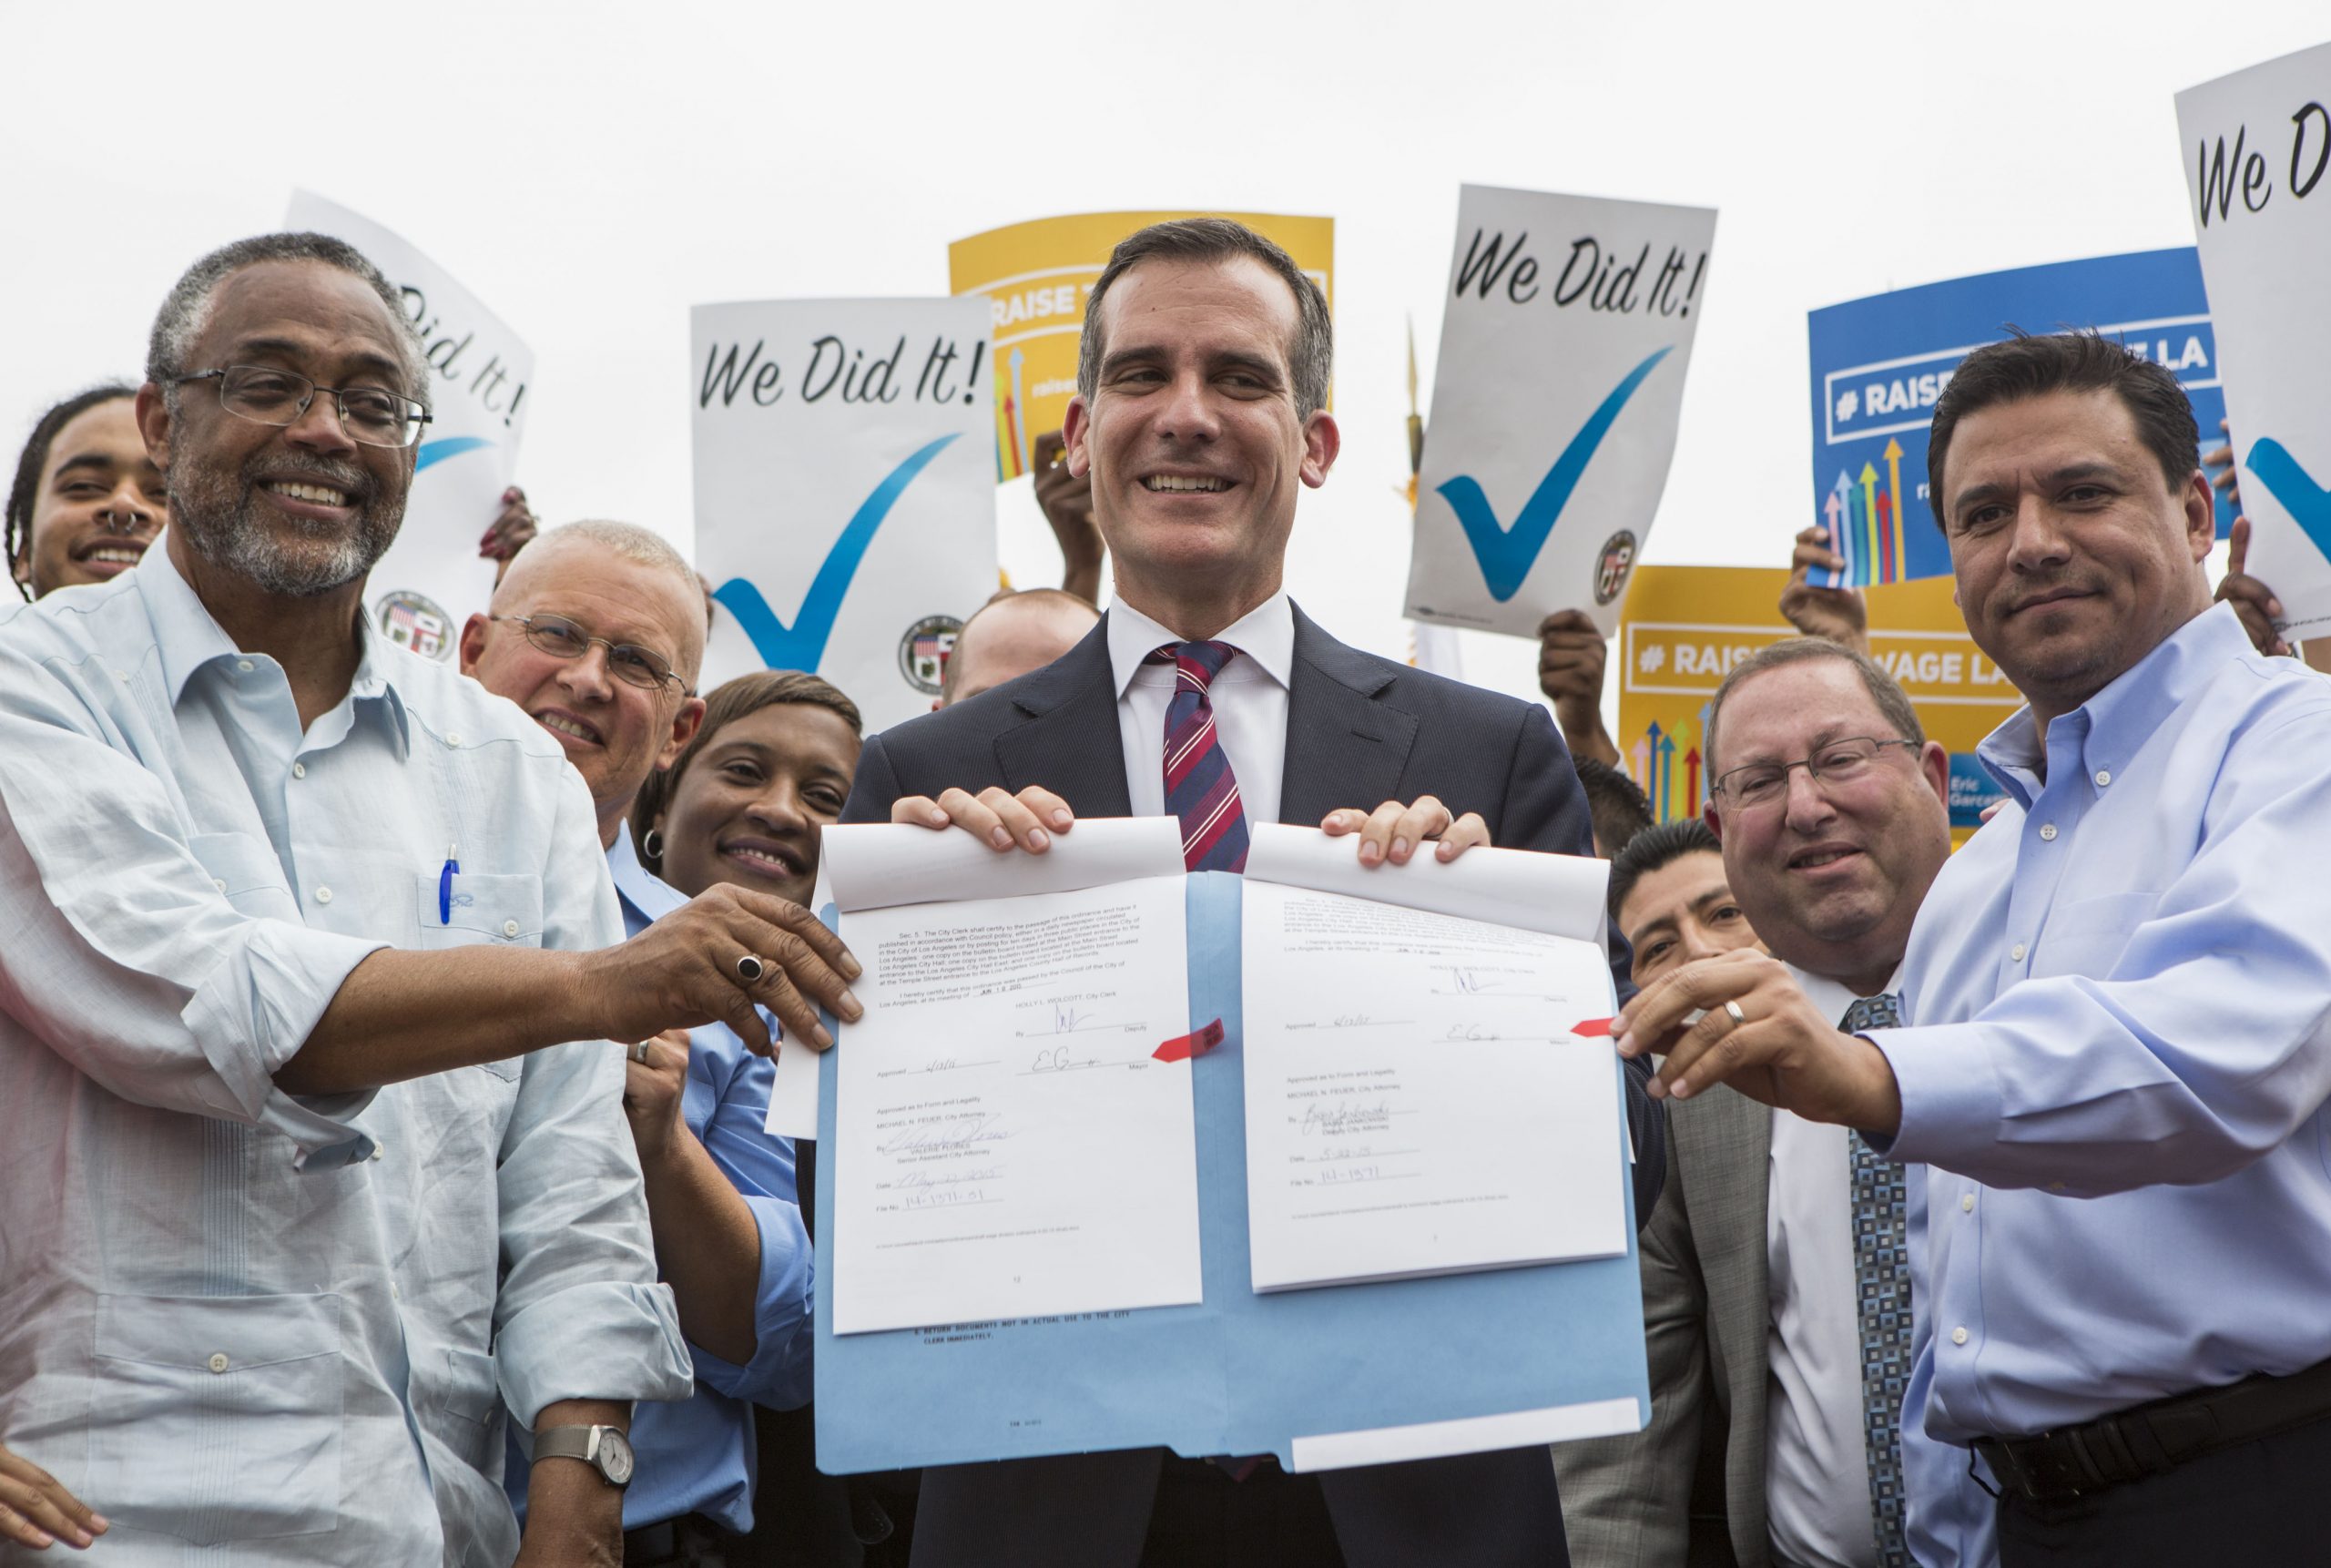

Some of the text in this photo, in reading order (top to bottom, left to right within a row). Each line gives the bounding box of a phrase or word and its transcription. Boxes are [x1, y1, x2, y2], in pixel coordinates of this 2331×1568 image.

[2199, 122, 2273, 229] We
[1455, 228, 1707, 320] We Did It!
[991, 284, 1076, 330] RAISE
[2156, 335, 2208, 372] LA
[469, 353, 525, 428] It!
[698, 335, 985, 410] We Did It!
[1674, 644, 1764, 677] RAIS
[1950, 775, 1980, 792] Eric
[1128, 1063, 1149, 1072] Mayor
[876, 1105, 907, 1115] Approved
[955, 1321, 997, 1331] DOCUMENTS
[1002, 1319, 1016, 1328] NOT
[1033, 1315, 1060, 1325] ACTUAL
[1064, 1313, 1078, 1322] USE
[1083, 1312, 1092, 1320] TO
[1095, 1310, 1110, 1319] THE
[1114, 1308, 1131, 1319] CITY
